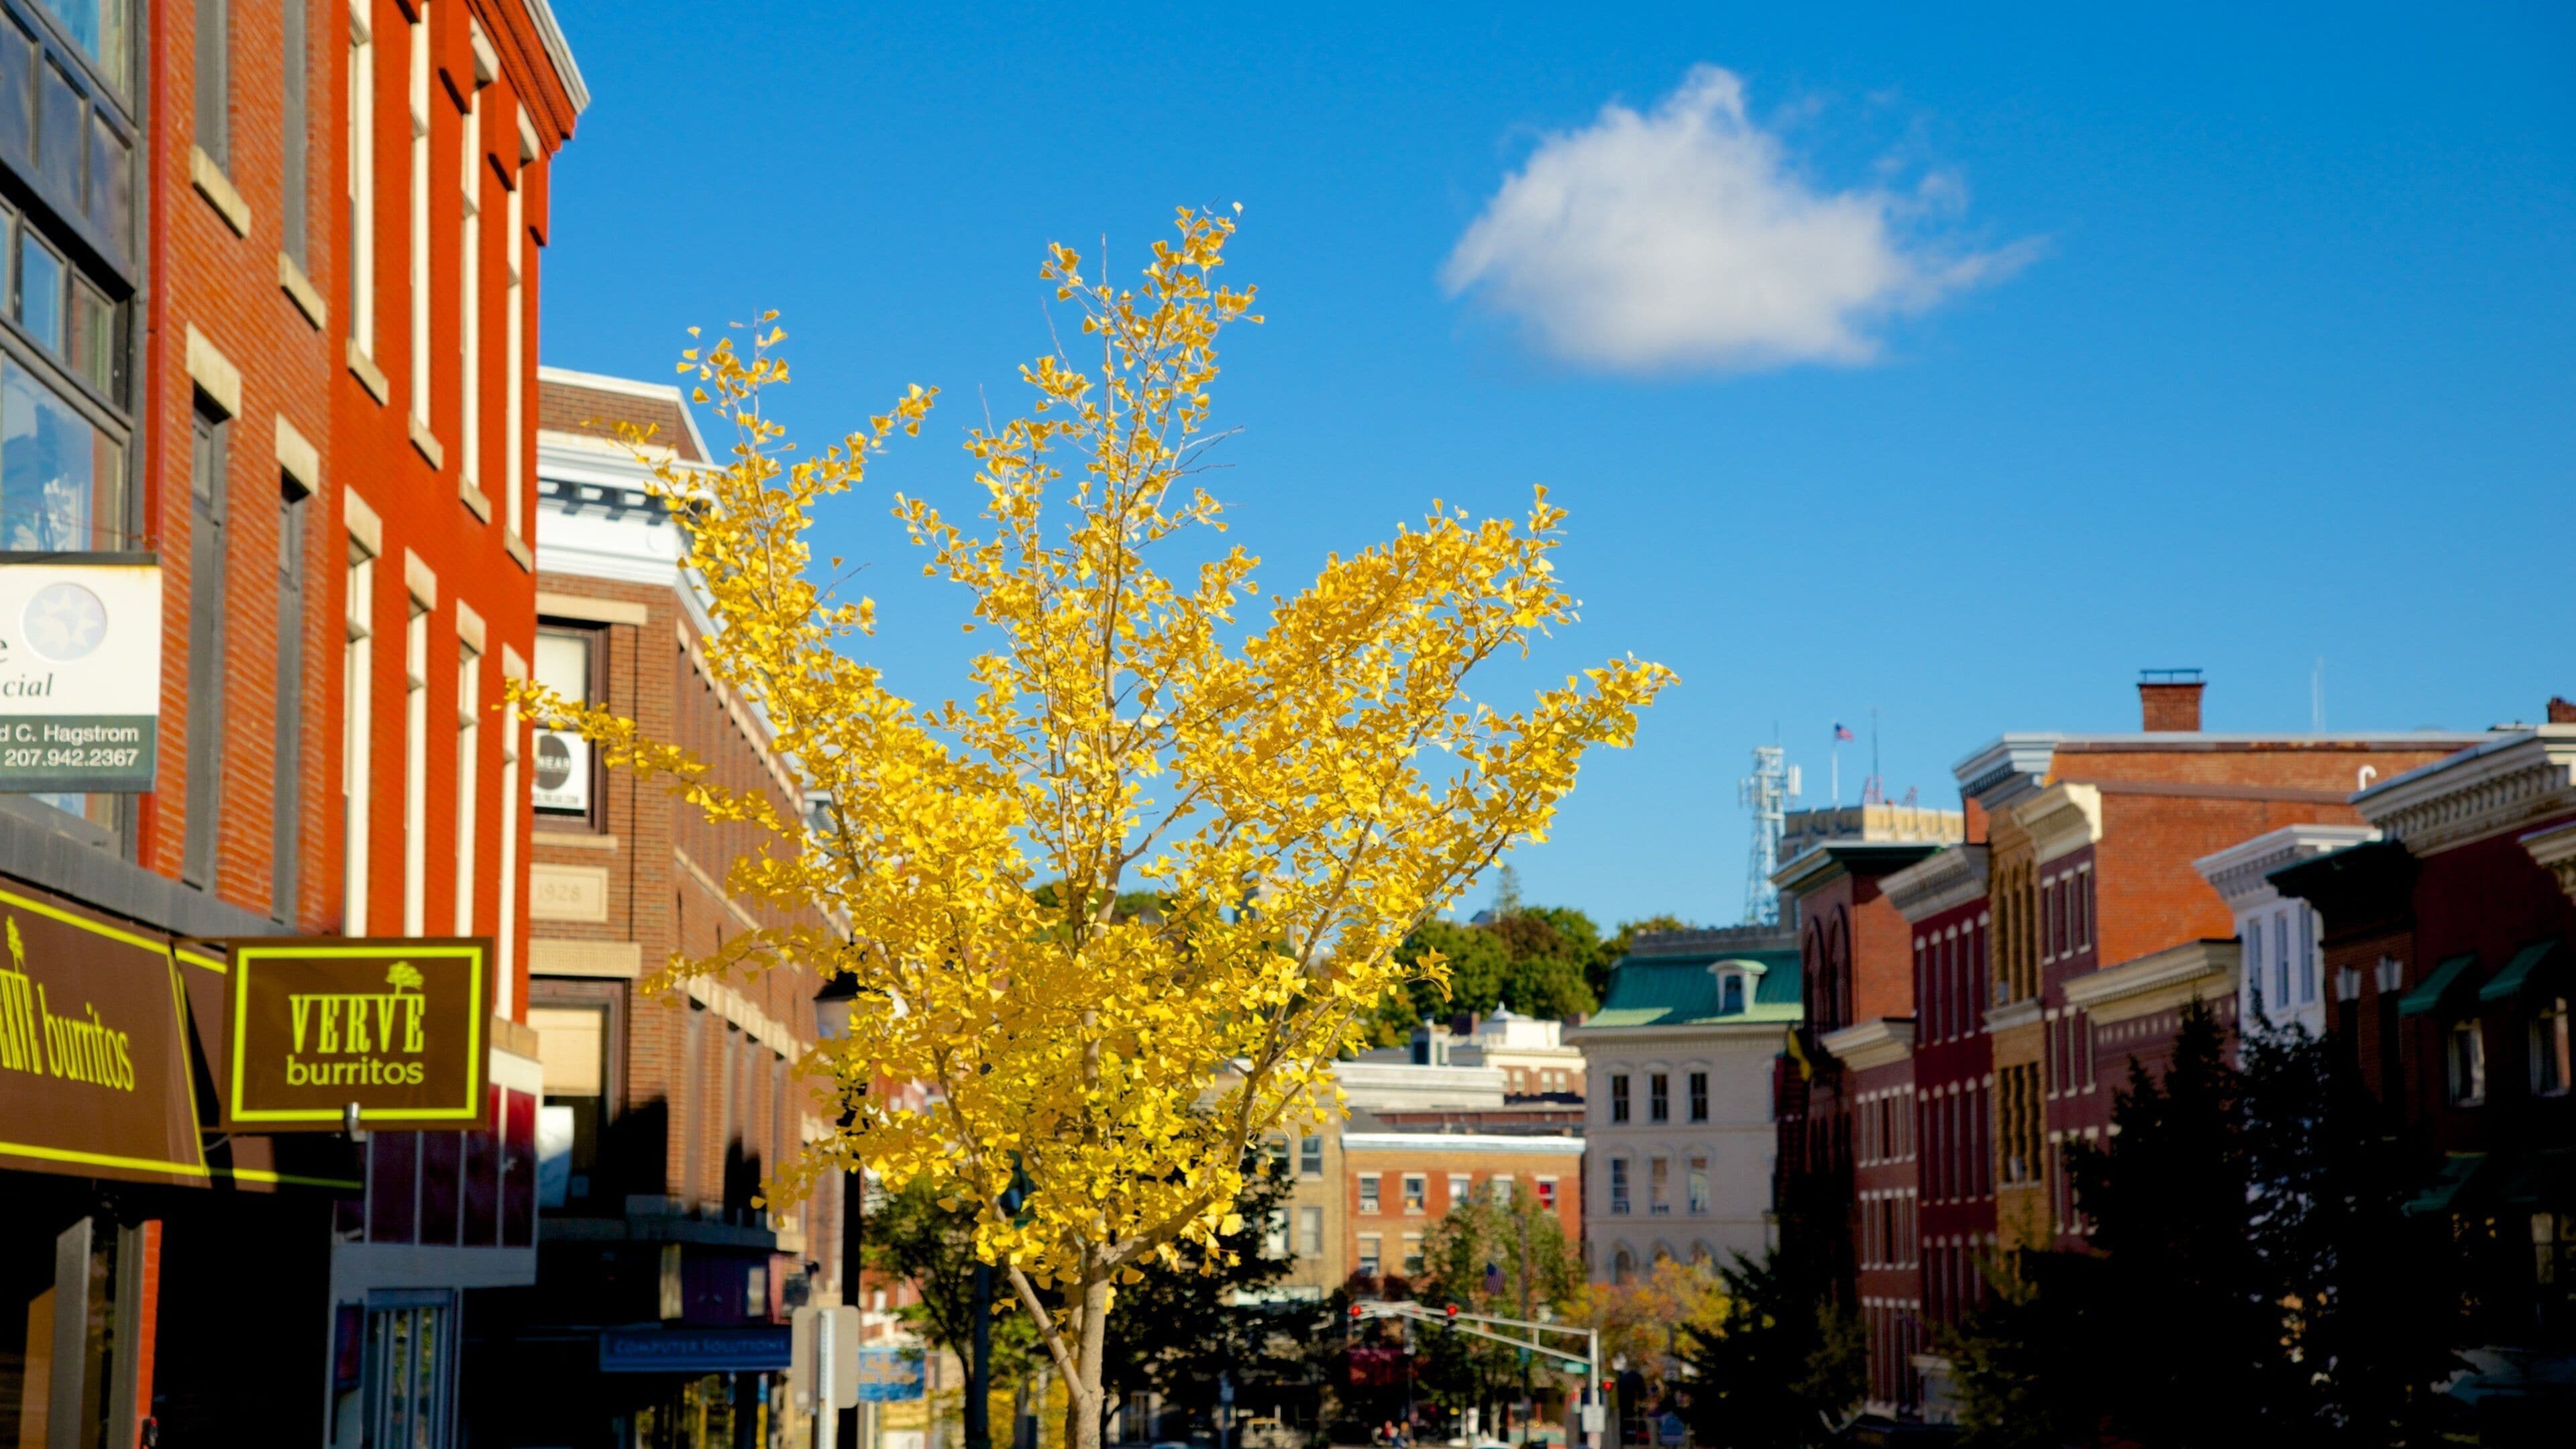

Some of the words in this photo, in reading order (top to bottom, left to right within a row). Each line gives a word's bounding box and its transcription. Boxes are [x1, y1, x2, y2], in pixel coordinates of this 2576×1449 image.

[15, 723, 38, 743] C.
[44, 724, 140, 747] Hagstrom
[4, 748, 139, 767] 207.942.2367
[538, 881, 582, 904] 1928
[37, 982, 134, 1092] burritos
[288, 994, 425, 1054] VERVE
[286, 1054, 424, 1086] burritos
